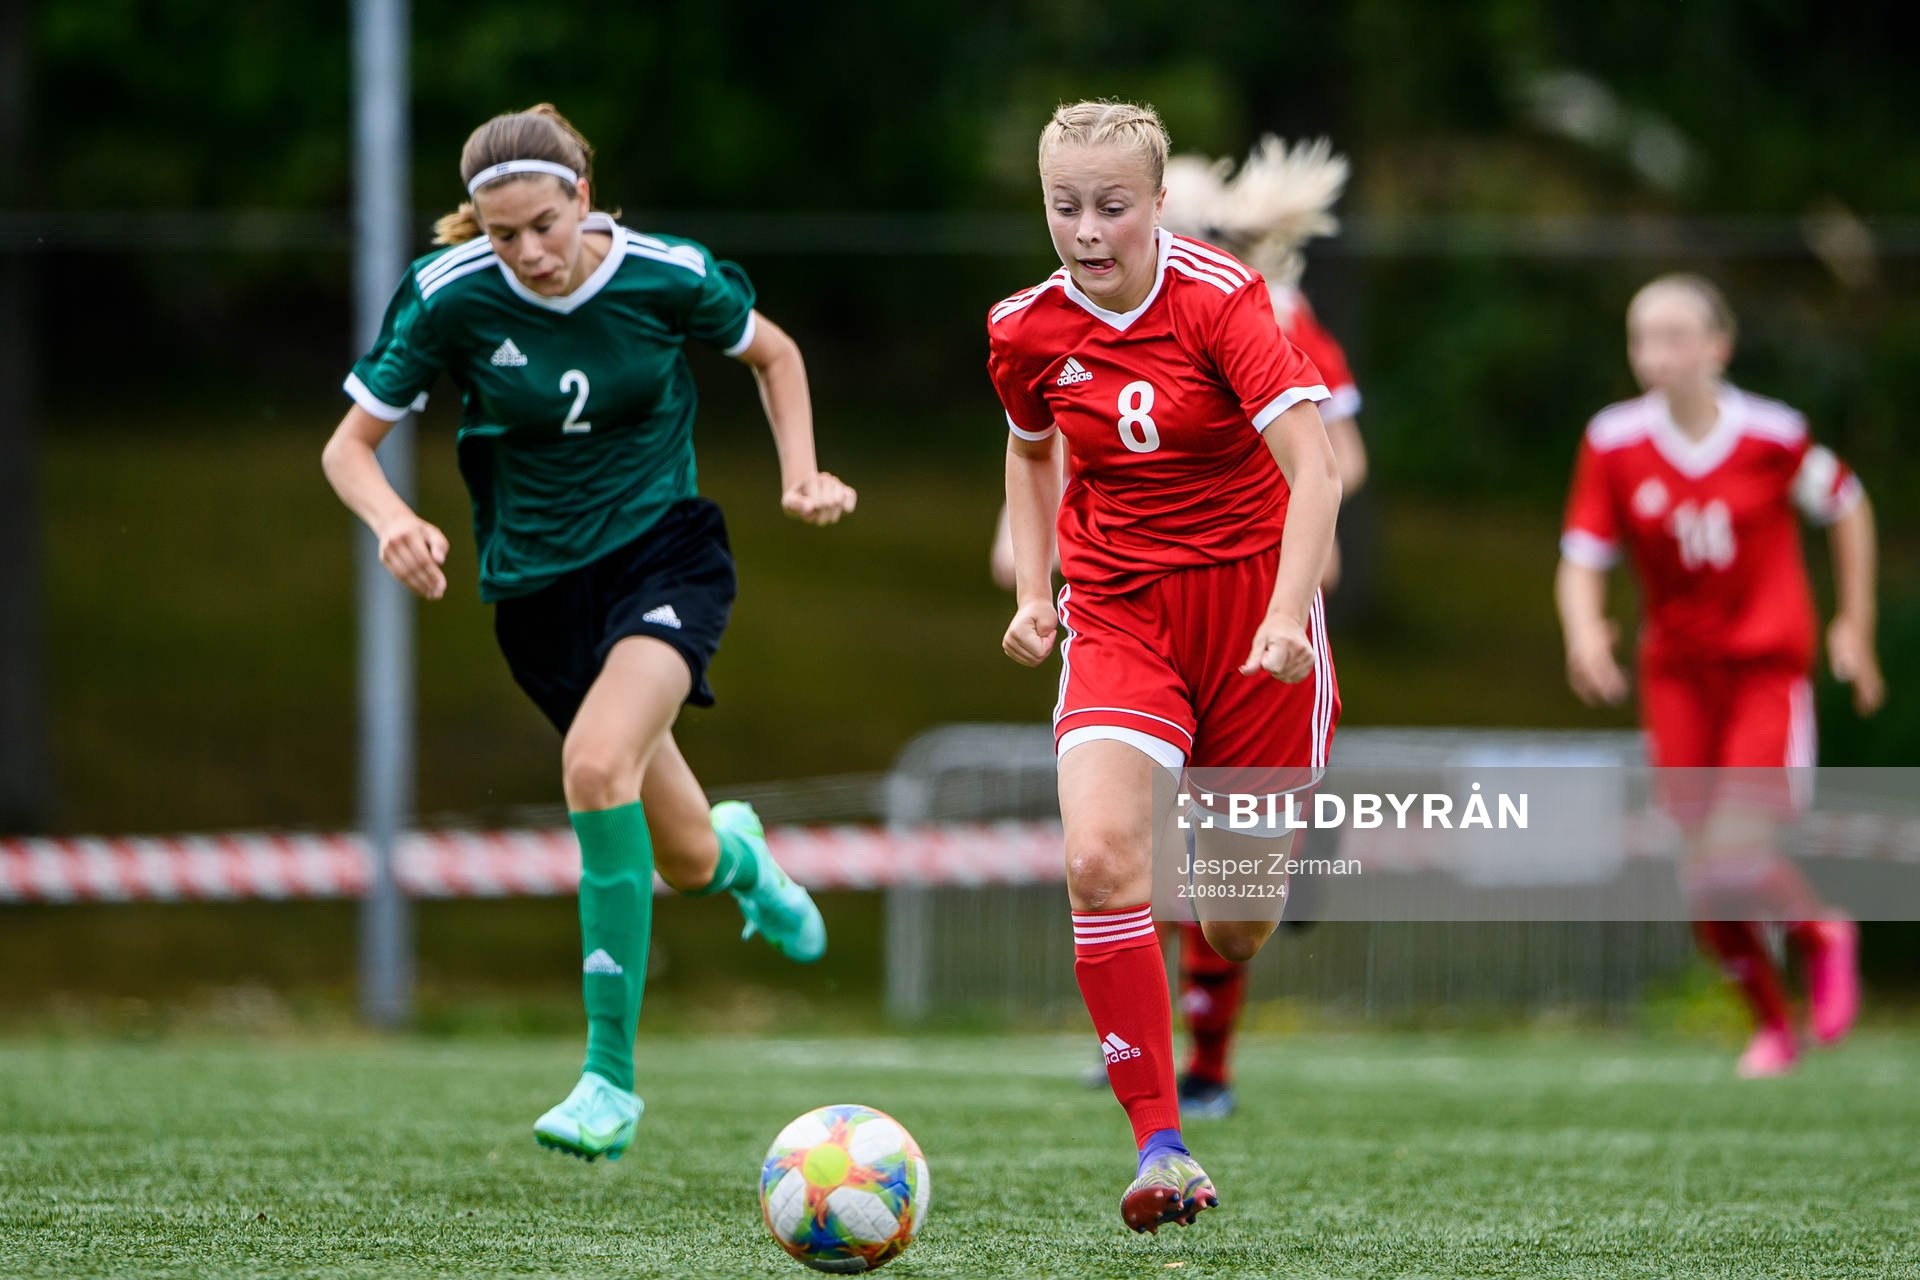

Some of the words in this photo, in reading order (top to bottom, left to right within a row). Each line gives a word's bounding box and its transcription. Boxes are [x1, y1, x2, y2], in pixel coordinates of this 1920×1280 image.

[1057, 371, 1093, 386] adidas
[560, 369, 591, 434] 2
[1117, 380, 1160, 453] 8
[1104, 1047, 1141, 1065] idas
